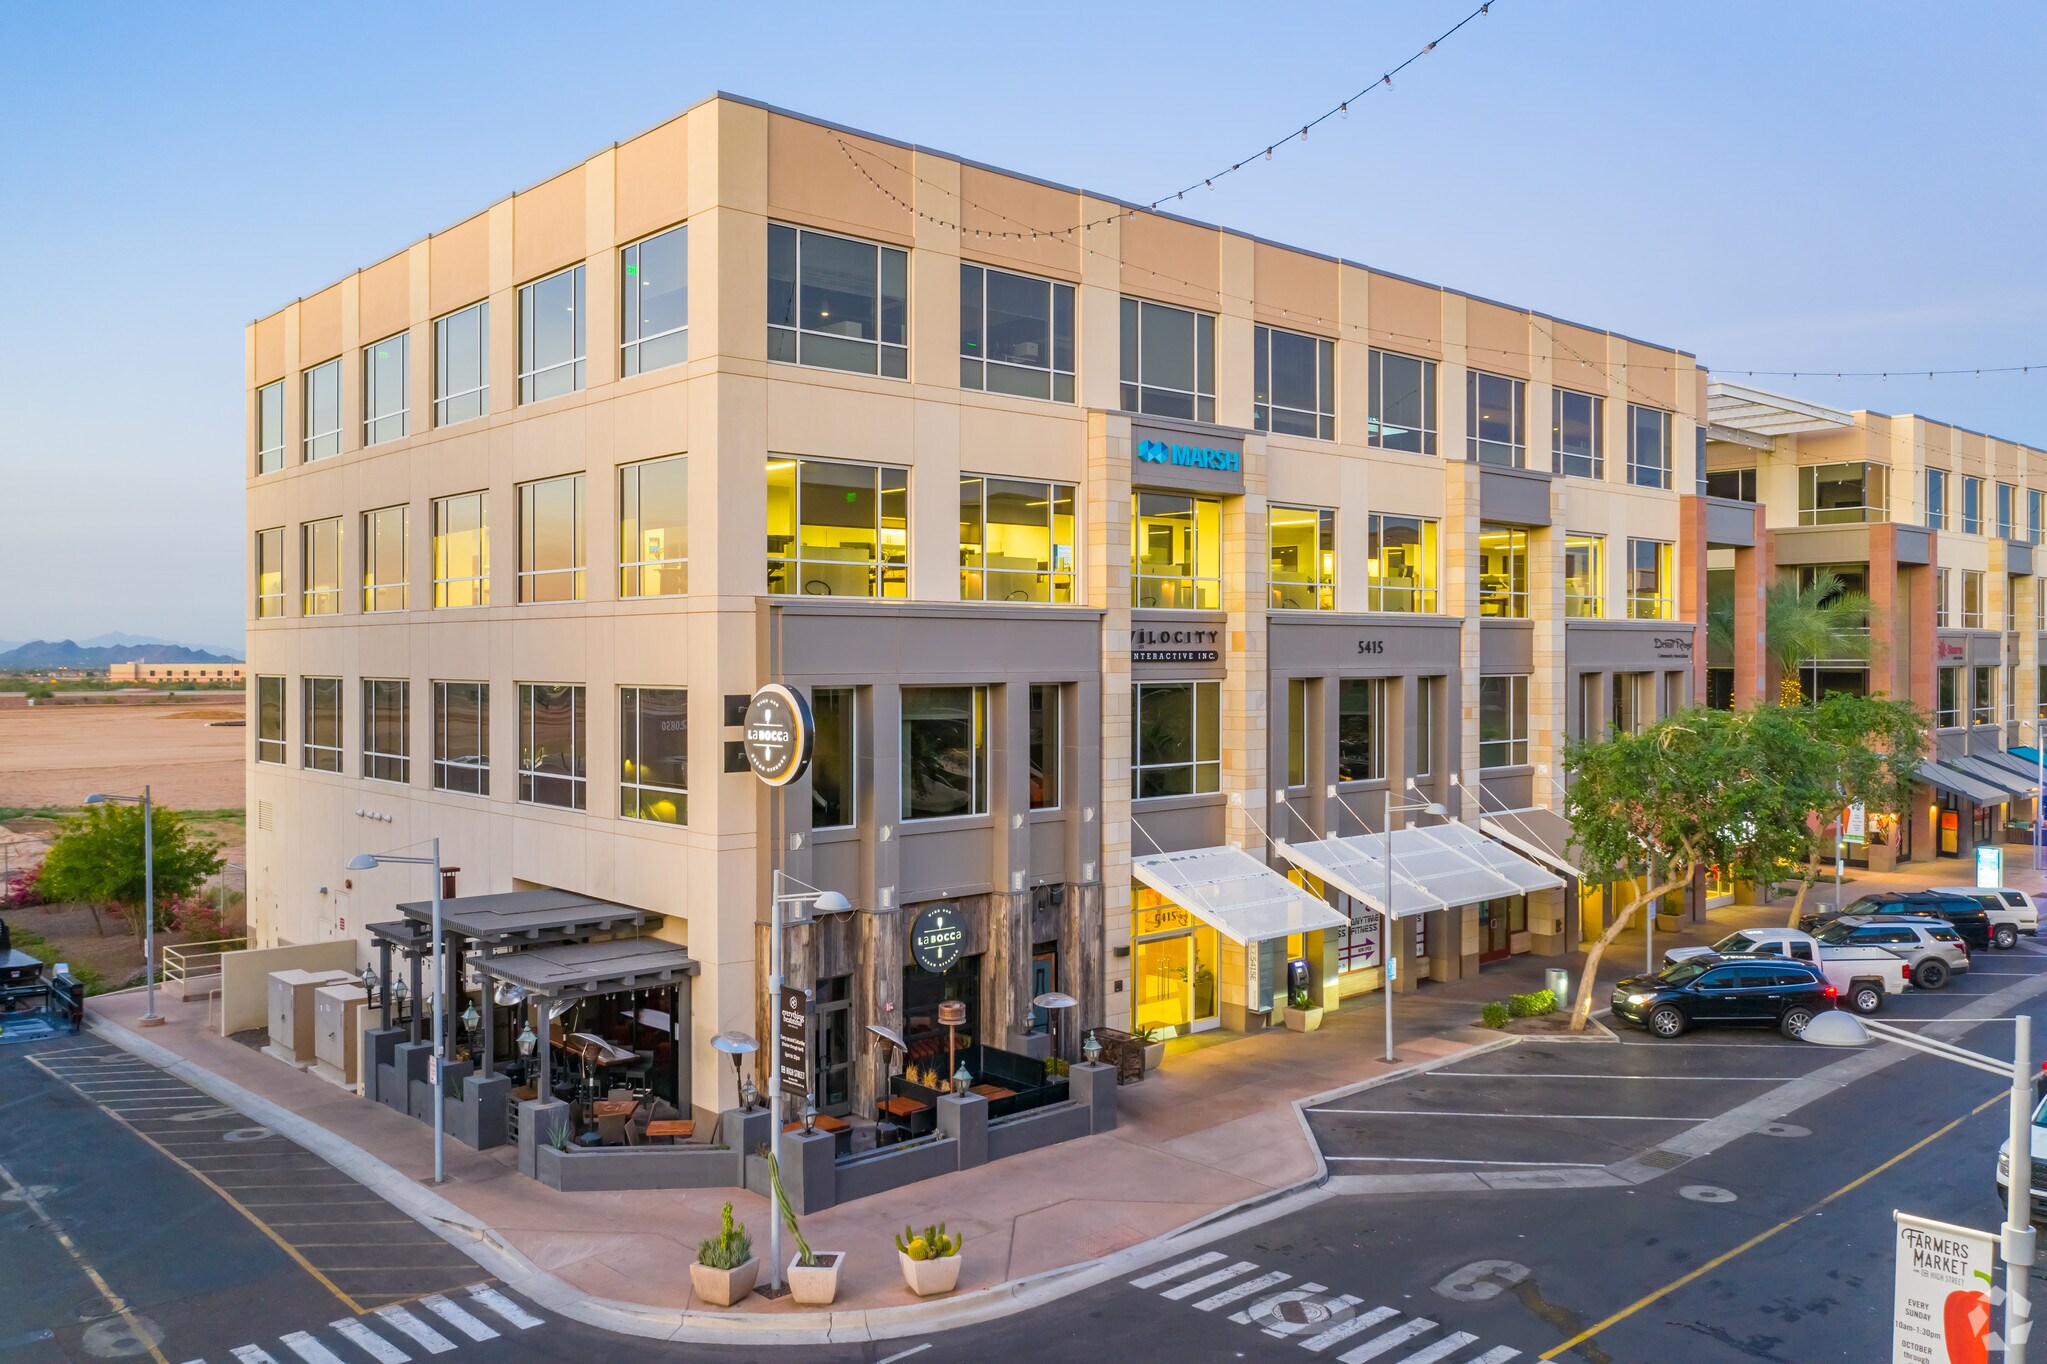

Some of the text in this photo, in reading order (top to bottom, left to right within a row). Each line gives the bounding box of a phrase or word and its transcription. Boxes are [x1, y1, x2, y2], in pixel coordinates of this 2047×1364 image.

[1171, 444, 1240, 472] MARSH
[1357, 640, 1384, 654] 5415
[1133, 652, 1216, 660] NTERACTIVE INC.
[1154, 911, 1177, 928] 5415
[1351, 923, 1378, 935] FITNESS
[1901, 1228, 1969, 1259] FARMERS
[1913, 1248, 1968, 1276] MARKET
[1930, 1271, 1945, 1282] HIGH
[1945, 1275, 1965, 1286] STREET
[1907, 1298, 1929, 1310] EVERY
[1905, 1308, 1931, 1321] SUNDAY
[1901, 1340, 1932, 1355] OCTOBER
[1903, 1351, 1930, 1364] through
